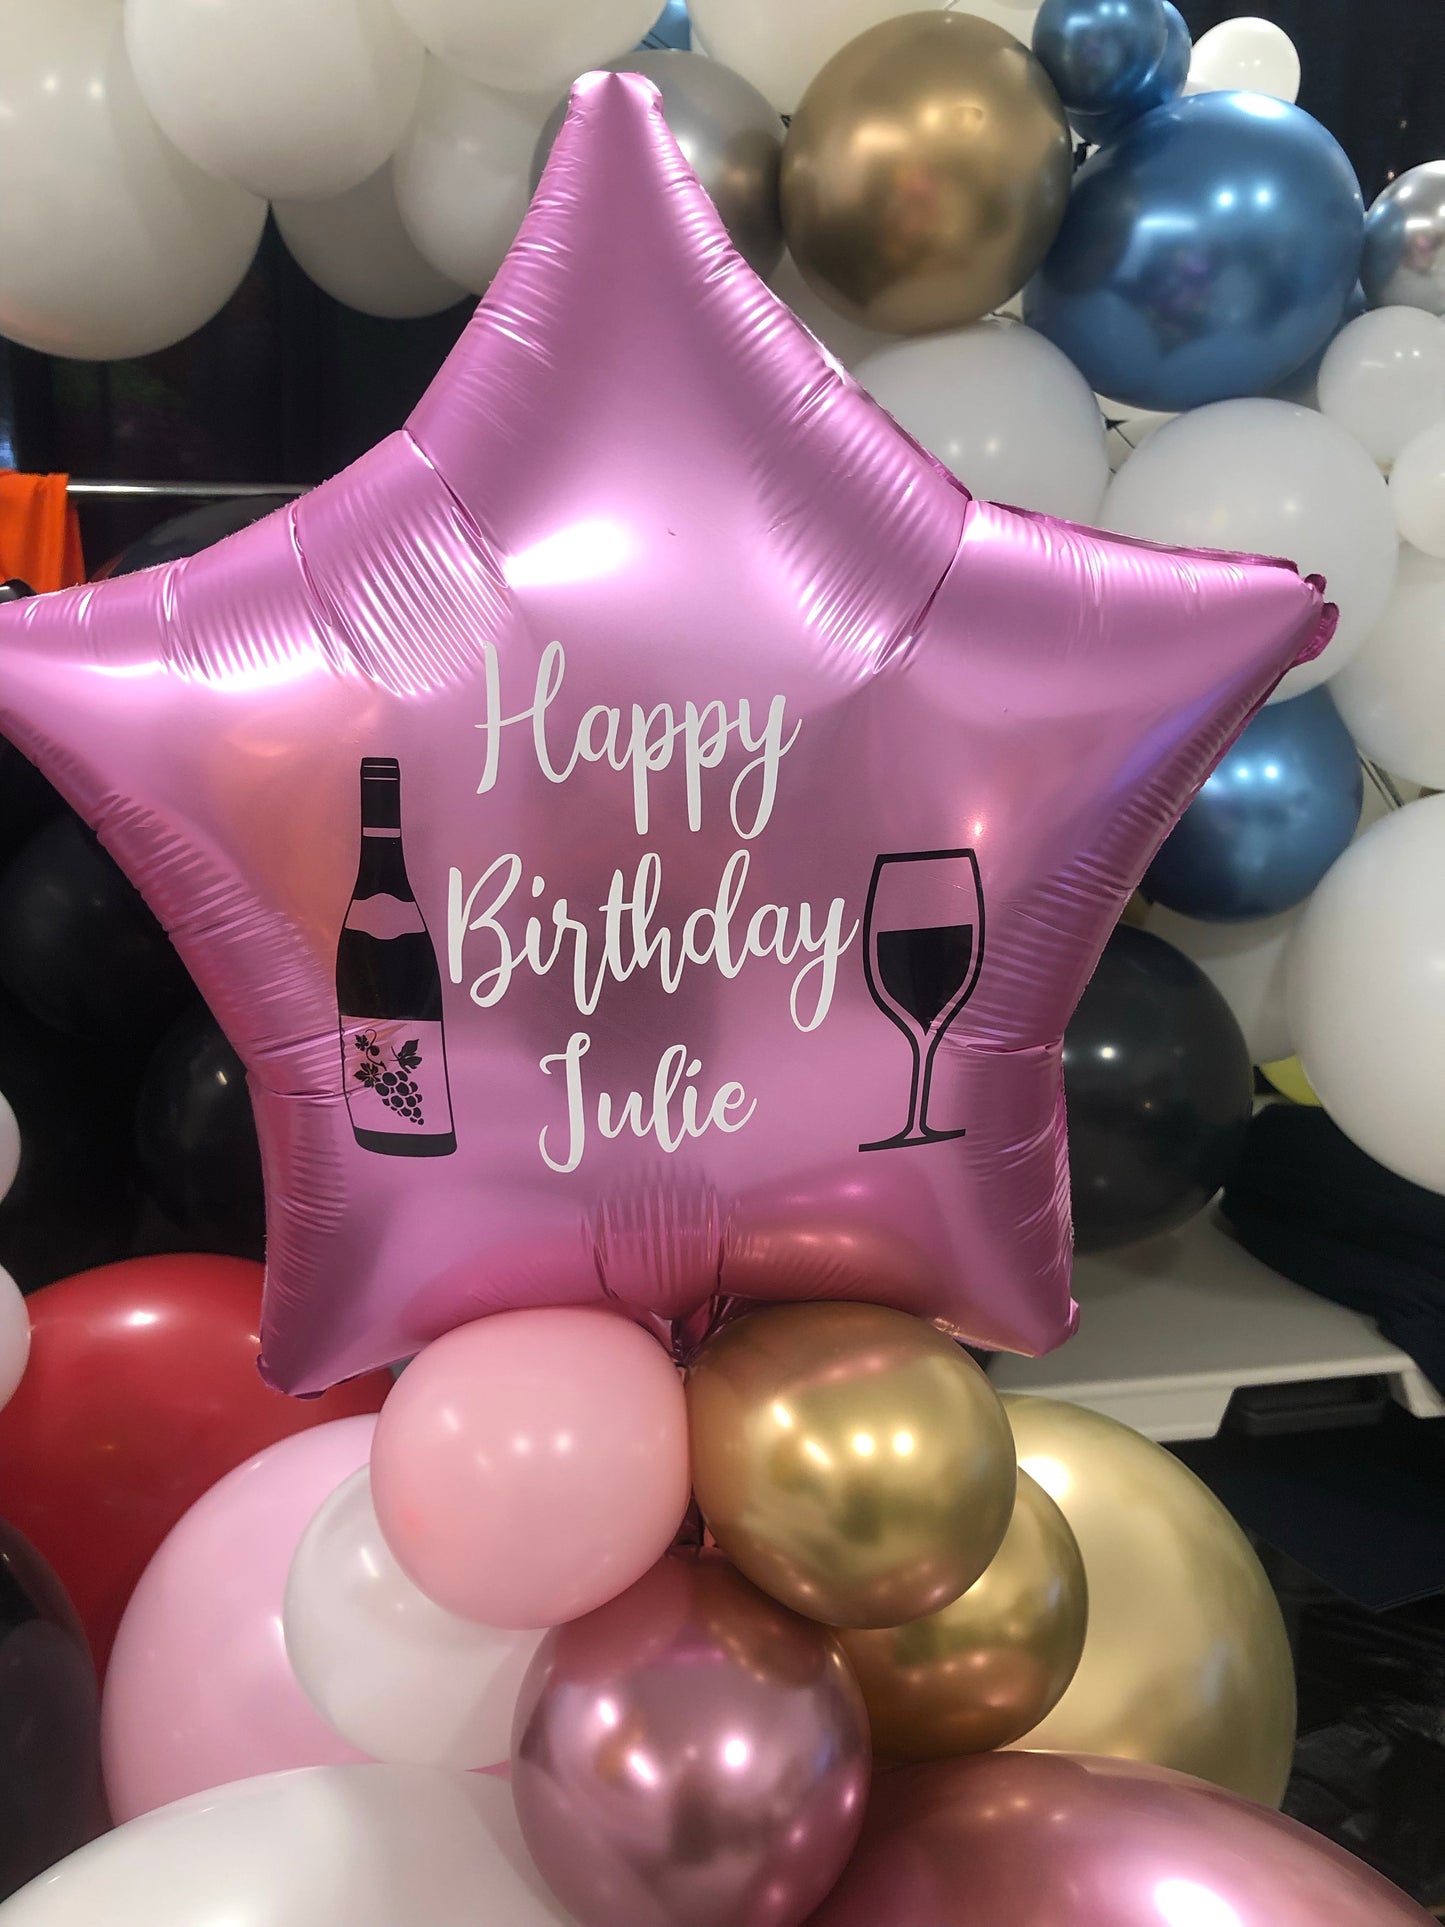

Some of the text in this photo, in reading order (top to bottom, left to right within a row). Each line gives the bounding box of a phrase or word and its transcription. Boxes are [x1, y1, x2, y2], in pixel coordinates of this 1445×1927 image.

[475, 640, 802, 839] Happy
[447, 849, 860, 1033] Birthday
[538, 1031, 758, 1173] Julie
